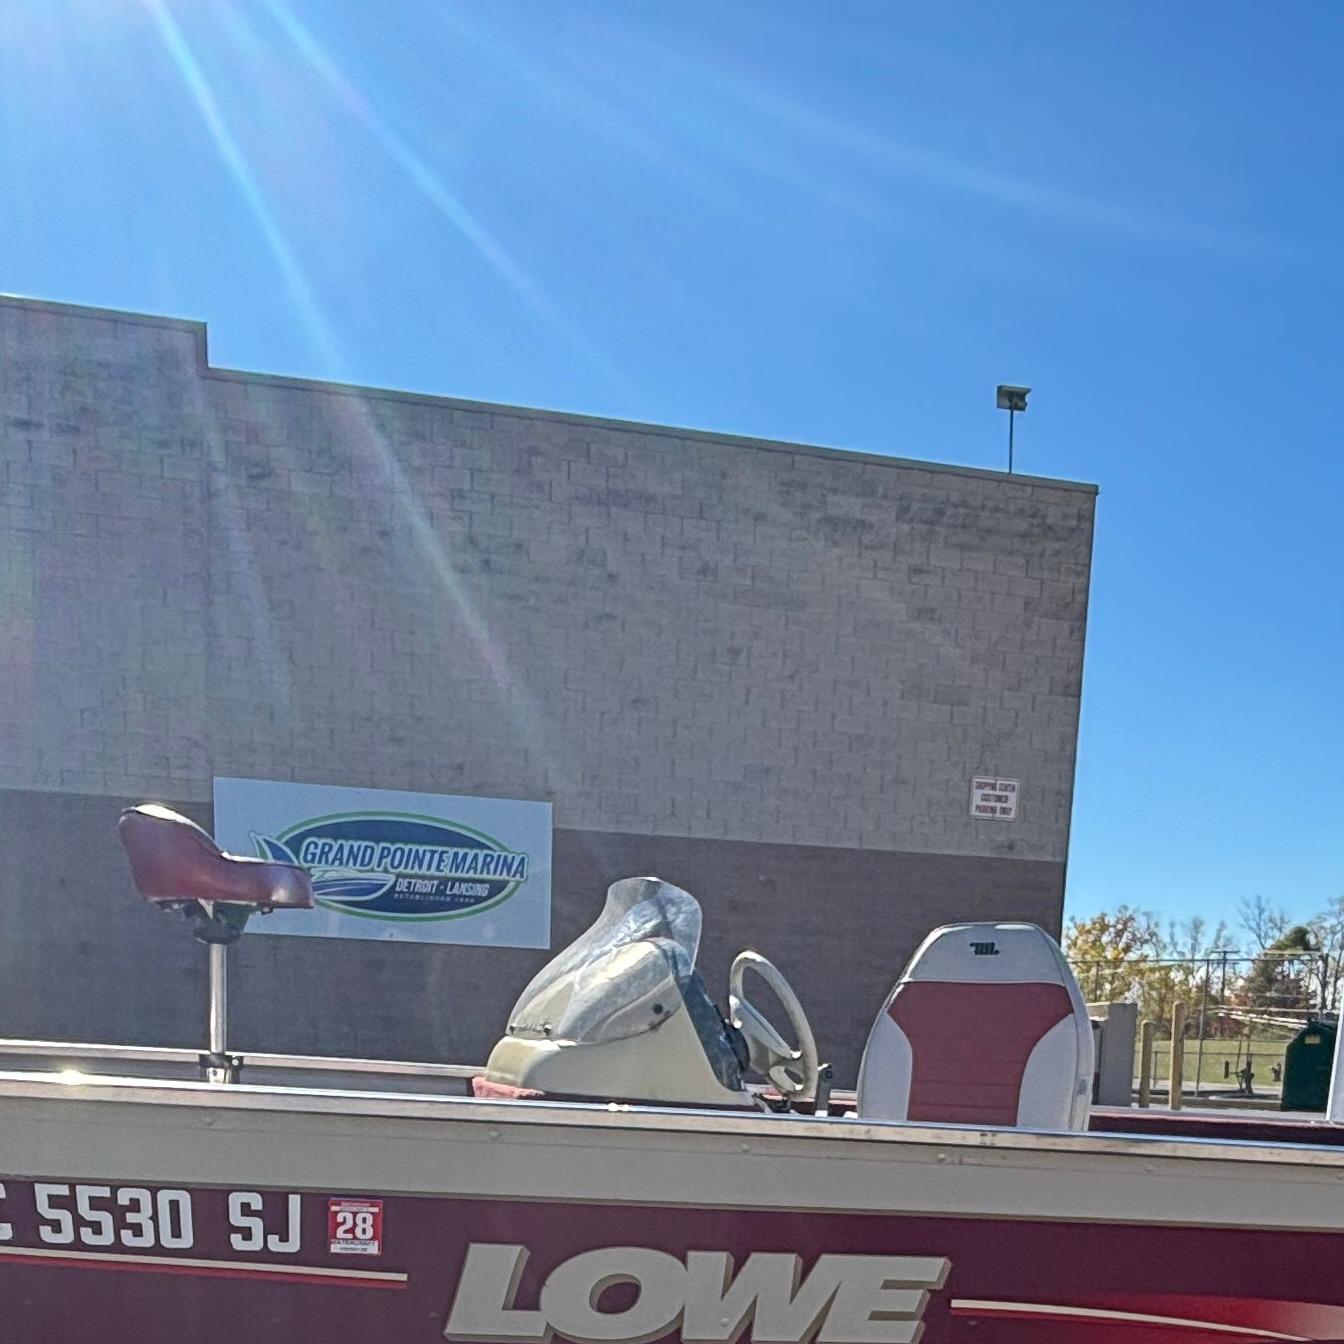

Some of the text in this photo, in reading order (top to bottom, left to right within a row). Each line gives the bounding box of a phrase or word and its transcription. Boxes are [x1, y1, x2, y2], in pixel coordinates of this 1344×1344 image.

[302, 839, 528, 880] GRAND POINTE MARINA
[396, 878, 440, 894] DETROIT
[446, 881, 490, 897] LANSING
[33, 1184, 195, 1250] 5530
[227, 1191, 302, 1254] SJ
[336, 1211, 374, 1240] 28
